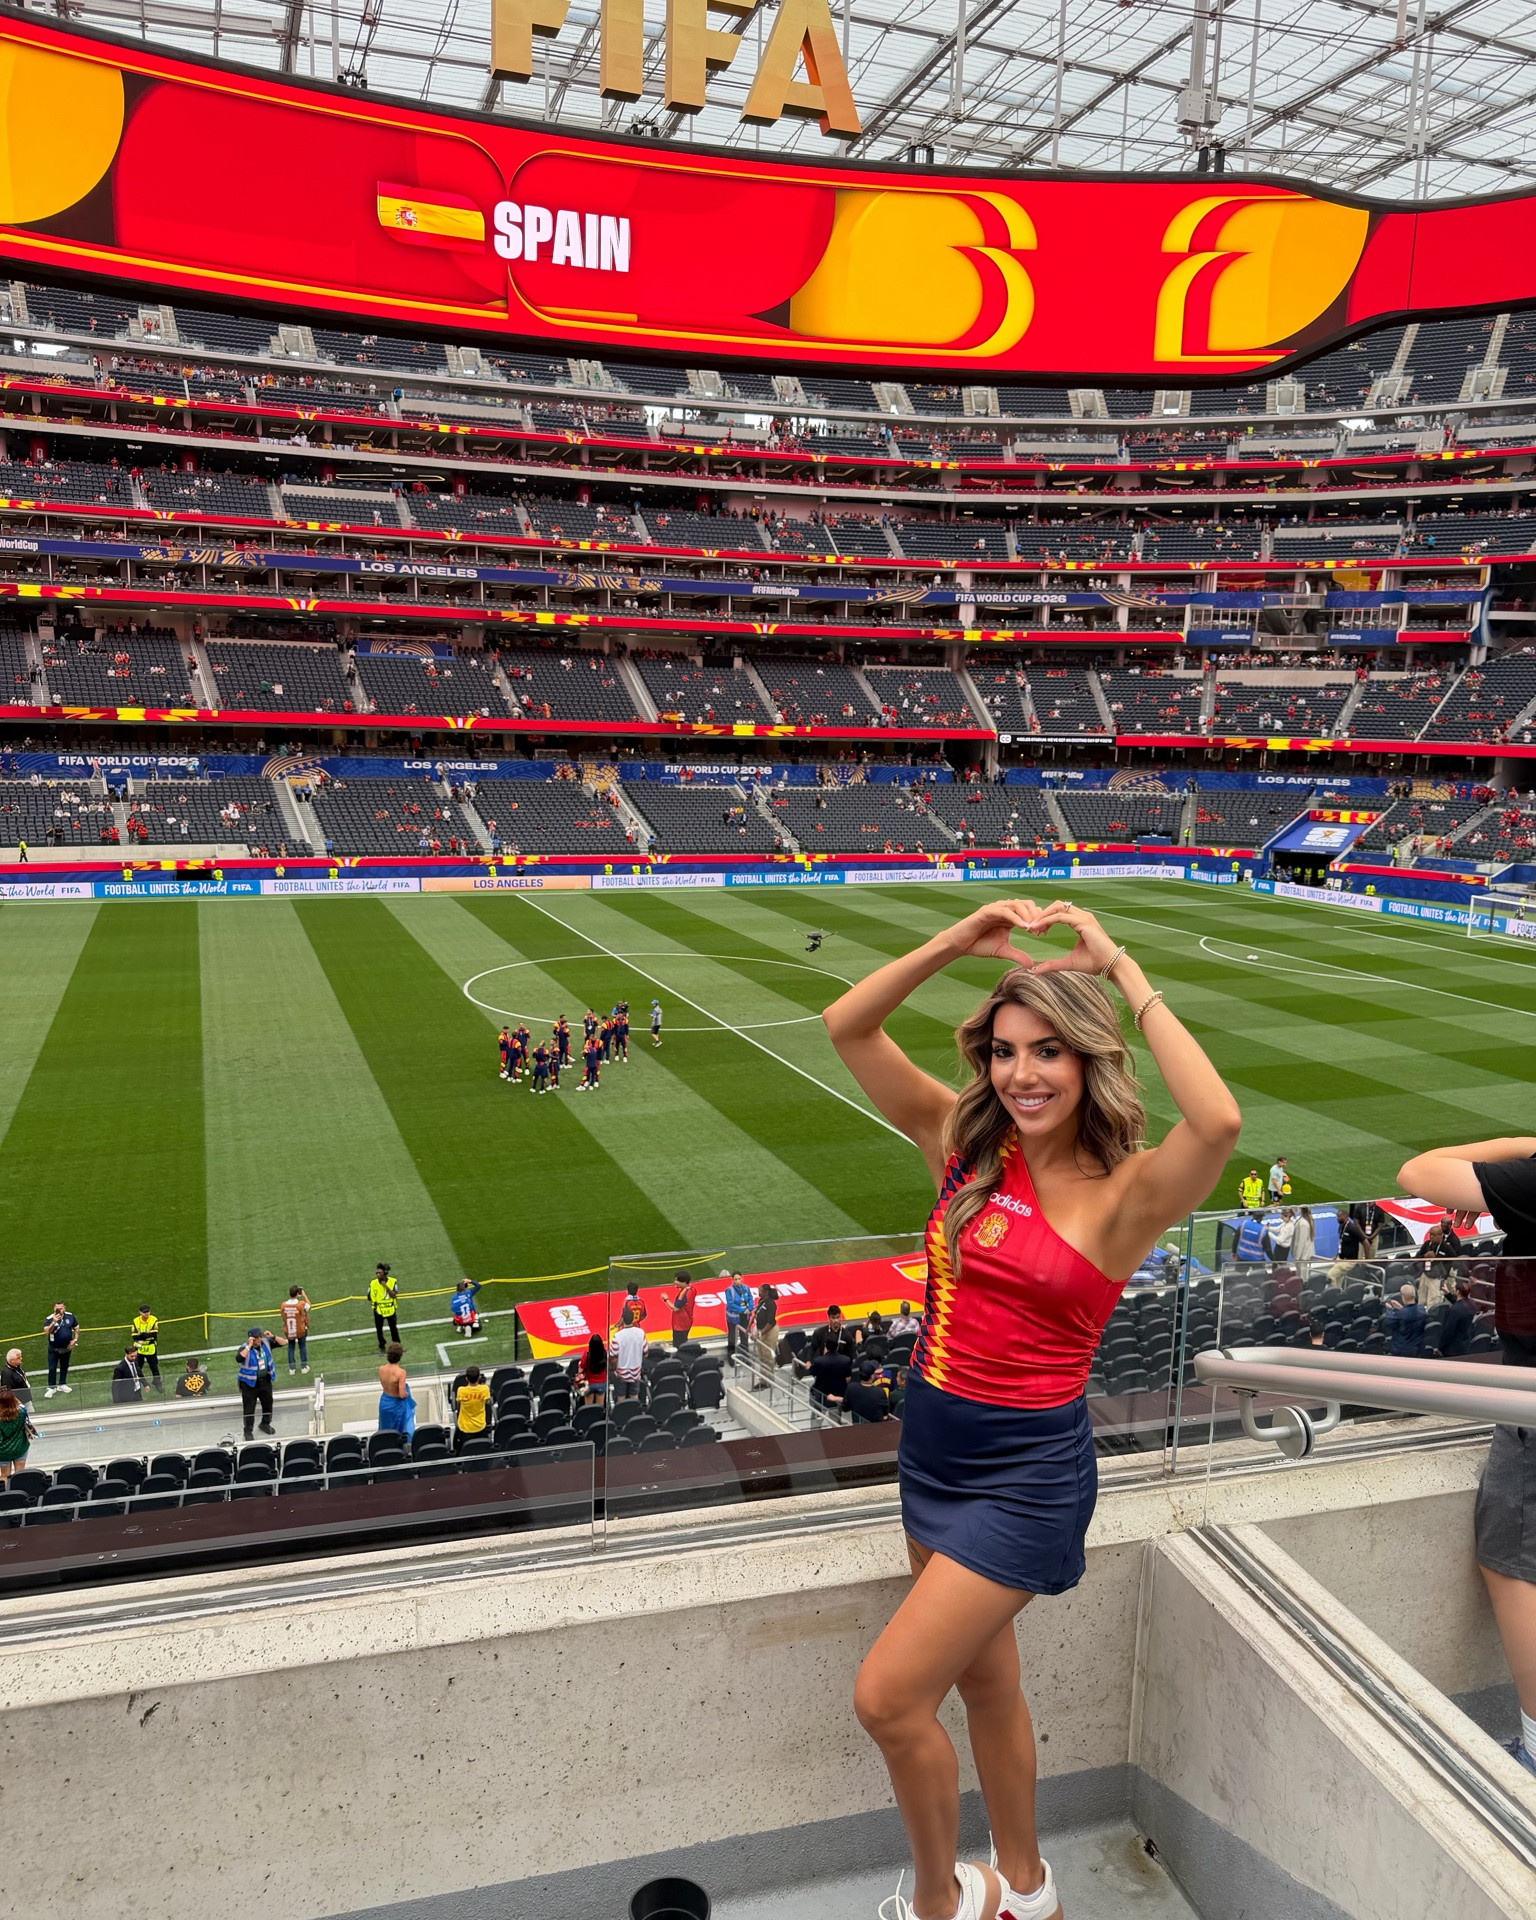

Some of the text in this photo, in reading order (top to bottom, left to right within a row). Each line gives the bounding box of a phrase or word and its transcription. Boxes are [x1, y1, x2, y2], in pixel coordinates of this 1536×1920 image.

[491, 0, 862, 139] FIFA
[494, 201, 631, 272] SPAIN
[360, 562, 478, 578] LOS ANGELES
[955, 594, 1067, 603] FIFA WORLD CUP 2026
[58, 756, 84, 765] FIFA
[720, 766, 740, 774] CUP
[732, 874, 763, 884] FOOTBALL
[765, 874, 786, 883] UNITES
[788, 873, 800, 883] the
[800, 872, 822, 883] World
[854, 872, 883, 881] FOOTBALL
[885, 872, 905, 880] UNITES
[919, 871, 939, 880] World
[970, 870, 997, 879] FOOTBALL
[999, 869, 1018, 878] UNITES
[1030, 868, 1050, 878] World
[1079, 868, 1104, 876] FOOTBALL
[274, 882, 313, 892] FOOTBALL
[316, 881, 344, 891] UNITES
[346, 880, 361, 890] the
[362, 880, 388, 890] World
[474, 879, 544, 888] LOS ANGELES
[602, 877, 635, 886] FOOTBALL
[637, 876, 660, 885] UNITES
[662, 876, 674, 885] the
[675, 876, 697, 885] World
[8, 884, 24, 897] the
[26, 885, 55, 897] World
[104, 883, 147, 895] FOOTBALL
[150, 882, 180, 894] UNITES
[181, 882, 198, 894] the
[199, 882, 227, 894] World
[1281, 885, 1305, 896] FOOTBALL
[1306, 888, 1325, 900] UNITES
[1389, 902, 1419, 916] FOOTBALL
[1421, 906, 1443, 920] UNITES
[1444, 909, 1457, 922] the
[990, 1192, 1032, 1217] adidas
